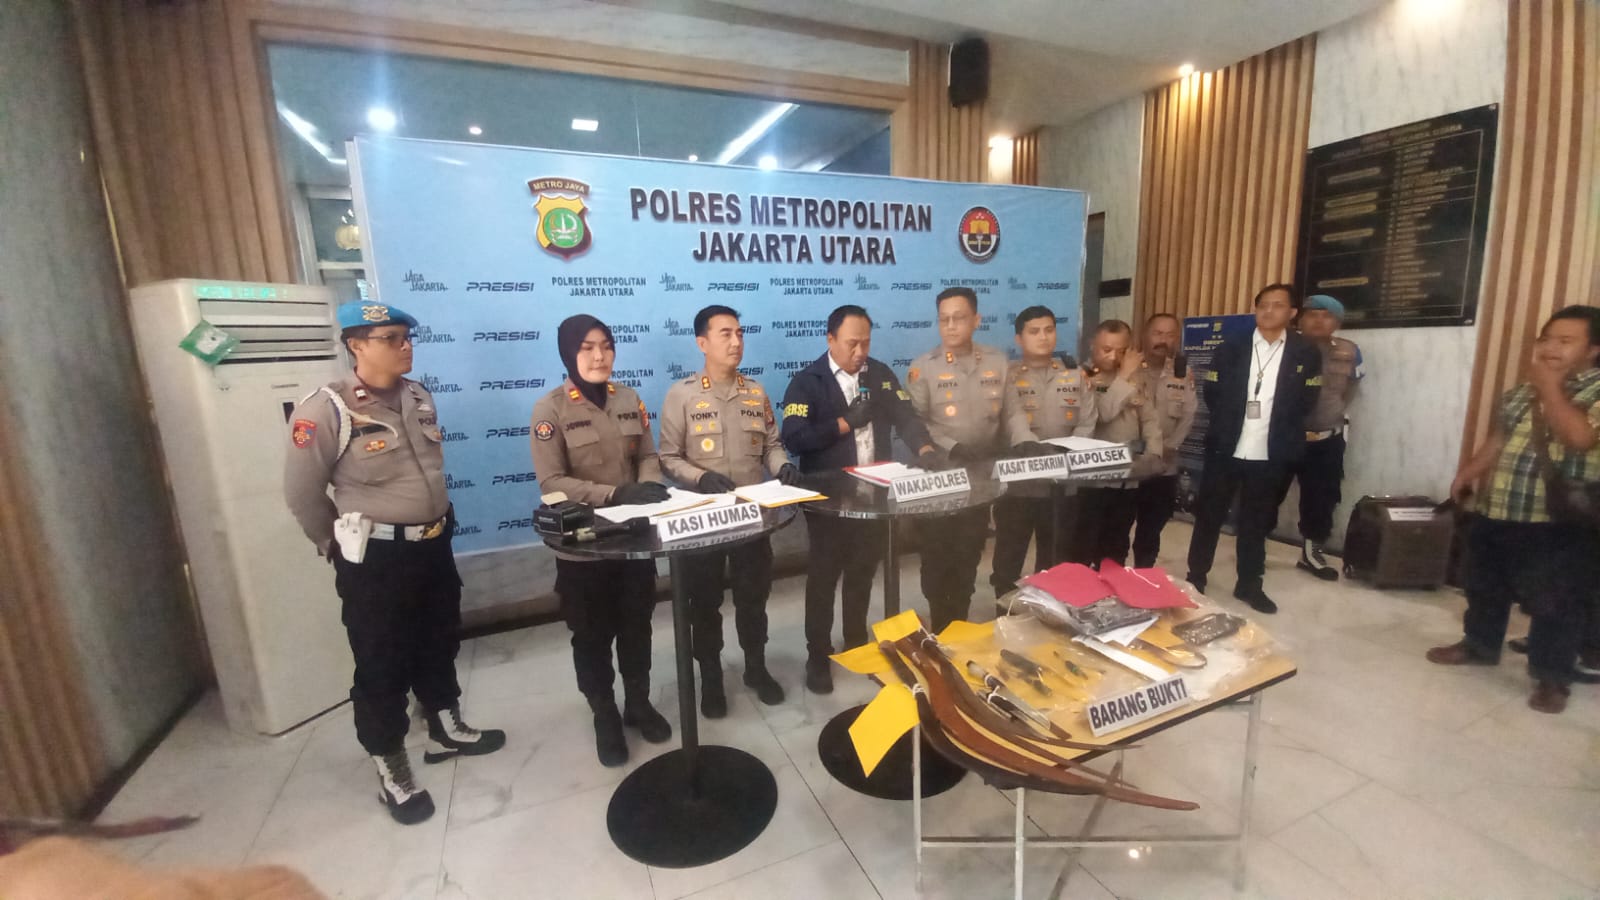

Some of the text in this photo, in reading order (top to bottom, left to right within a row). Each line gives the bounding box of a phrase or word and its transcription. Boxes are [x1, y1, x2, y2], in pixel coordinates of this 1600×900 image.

[533, 181, 585, 193] METRO JAYA
[629, 187, 932, 233] POLRES METROPOLITAN
[692, 231, 897, 265] JAKARTA UTARA
[466, 282, 535, 292] PRESISI
[551, 276, 647, 287] POLRES METROPOLITAN
[707, 282, 760, 292] PRESISI
[770, 278, 843, 287] POLRES METROPOLITAN
[890, 282, 933, 291] PRESISI
[569, 287, 635, 297] JAKARTA UTARA
[783, 287, 834, 296] JAKARTA UTARA
[772, 320, 828, 329] POLRES METROPO
[473, 331, 540, 342] PRESISI
[785, 329, 813, 338] JAKARTA
[774, 360, 799, 370] POLRES
[611, 369, 654, 379] ROPOLITAN
[479, 378, 546, 391] PRESISI
[690, 410, 719, 421] YONKY
[486, 426, 531, 439] PRES
[1069, 449, 1128, 467] KAPOLSEK
[1000, 455, 1066, 476] KASAT RESKRIM
[492, 472, 537, 486] PRES
[895, 472, 968, 497] WAKAPOLRES
[667, 504, 759, 536] KASI HUMAS
[1089, 678, 1189, 730] BARANG BUKTI
